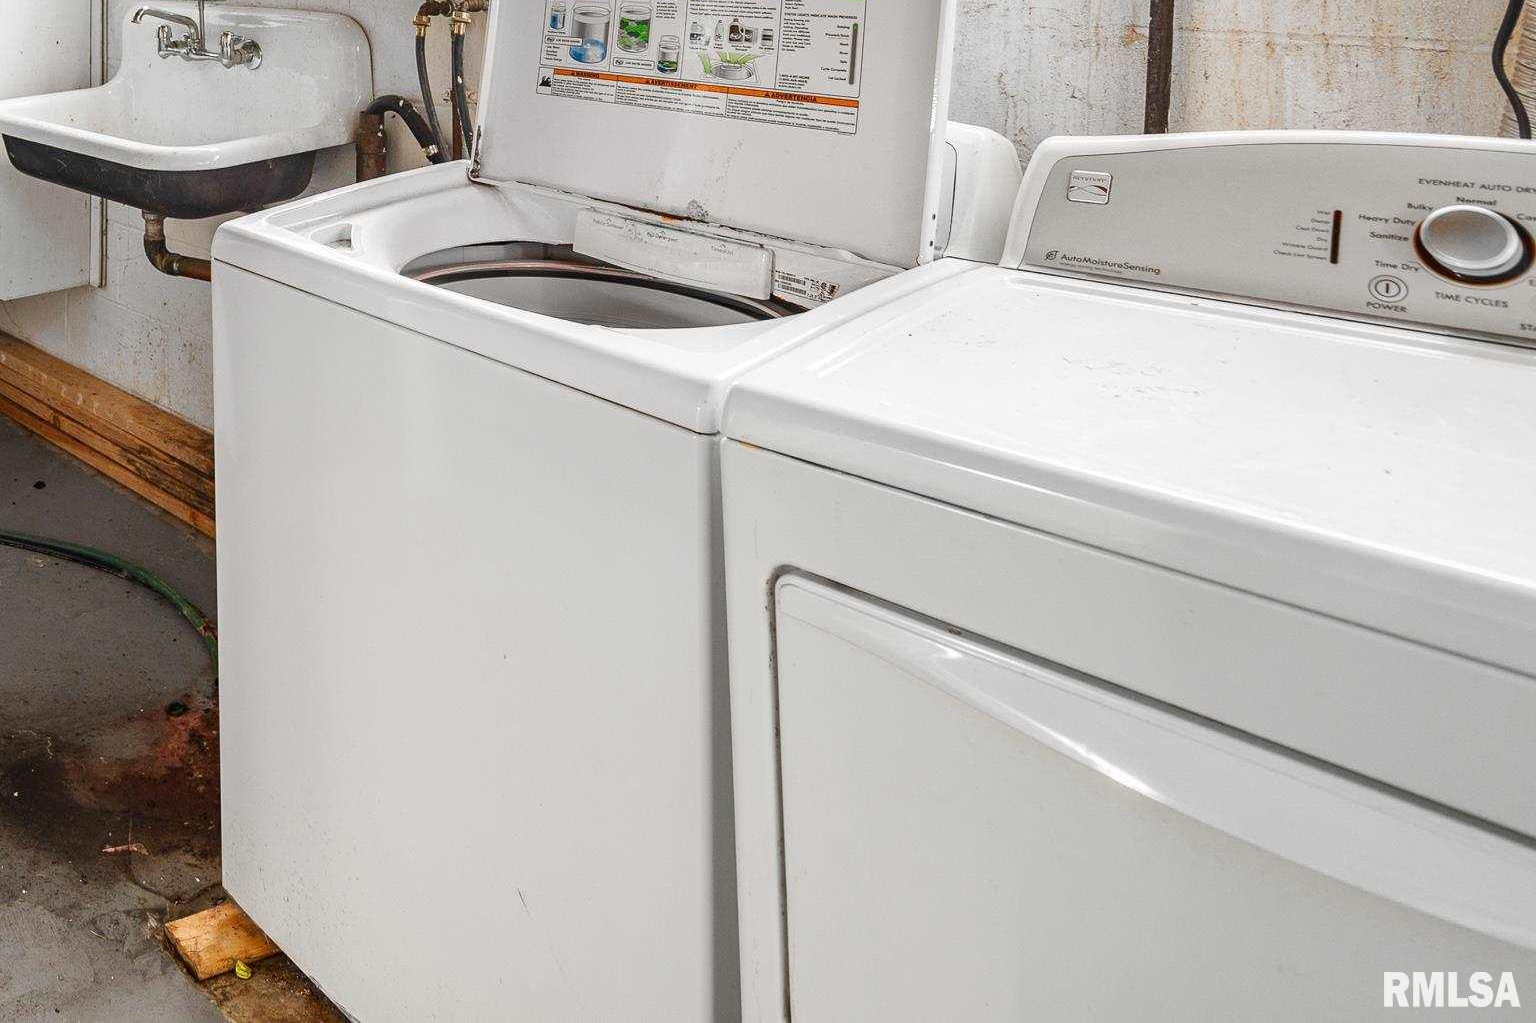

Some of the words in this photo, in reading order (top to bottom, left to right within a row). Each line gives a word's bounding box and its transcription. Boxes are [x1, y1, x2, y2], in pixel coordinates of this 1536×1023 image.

[772, 92, 817, 102] ADVERTENCIA
[1418, 178, 1475, 188] EVENHEAT
[1479, 184, 1512, 192] AUTO
[1456, 196, 1497, 206] Normal
[1407, 203, 1434, 211] Bulky
[1359, 214, 1389, 224] Heavy
[1393, 217, 1416, 226] Duty
[1369, 232, 1409, 241] Sanitize
[1061, 254, 1160, 275] AutoMoistureSensing
[1375, 260, 1398, 269] Time
[1402, 264, 1419, 272] Dry
[1435, 292, 1461, 302] TIME
[1465, 296, 1508, 308] CYCLES
[1366, 302, 1407, 312] POWER
